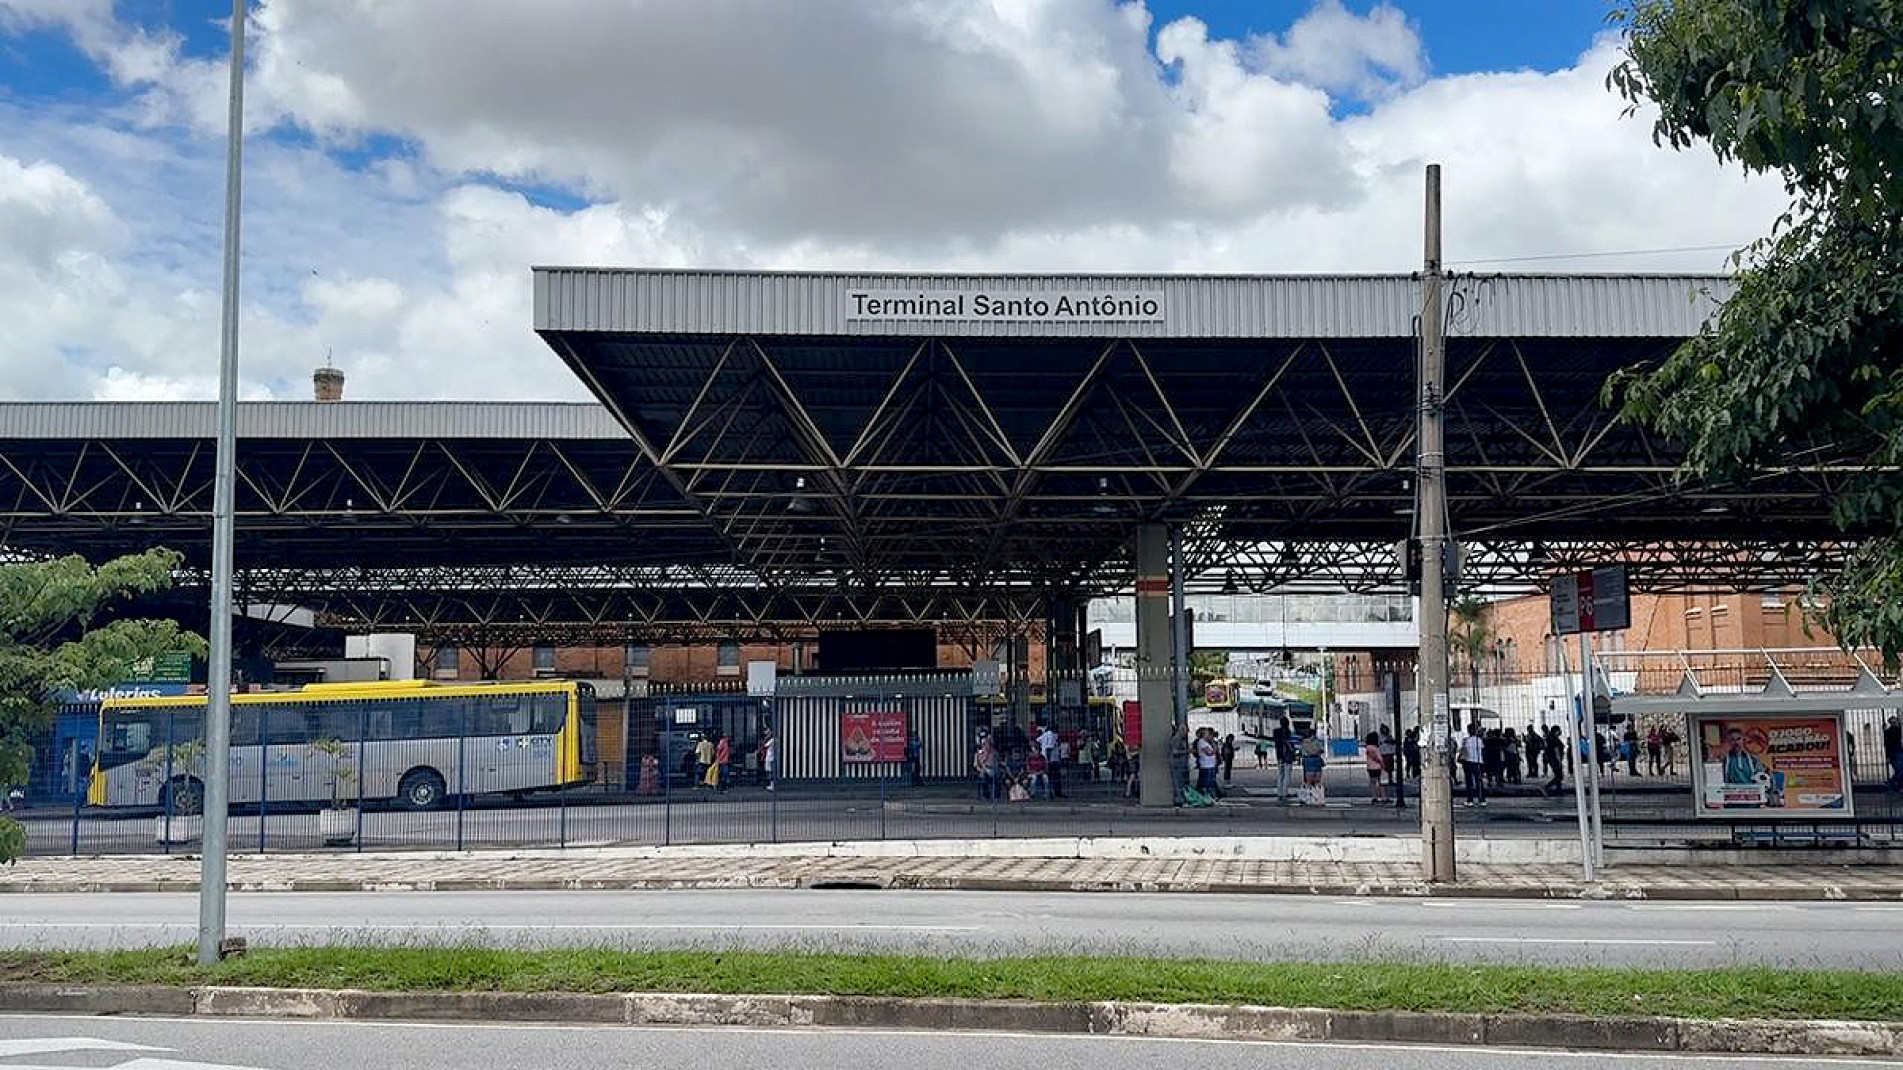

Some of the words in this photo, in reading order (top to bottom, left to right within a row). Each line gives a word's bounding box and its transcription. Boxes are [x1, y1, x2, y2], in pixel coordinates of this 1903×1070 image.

[852, 294, 964, 316] Terminal
[973, 294, 1049, 317] Santo
[1054, 295, 1159, 317] Antônio
